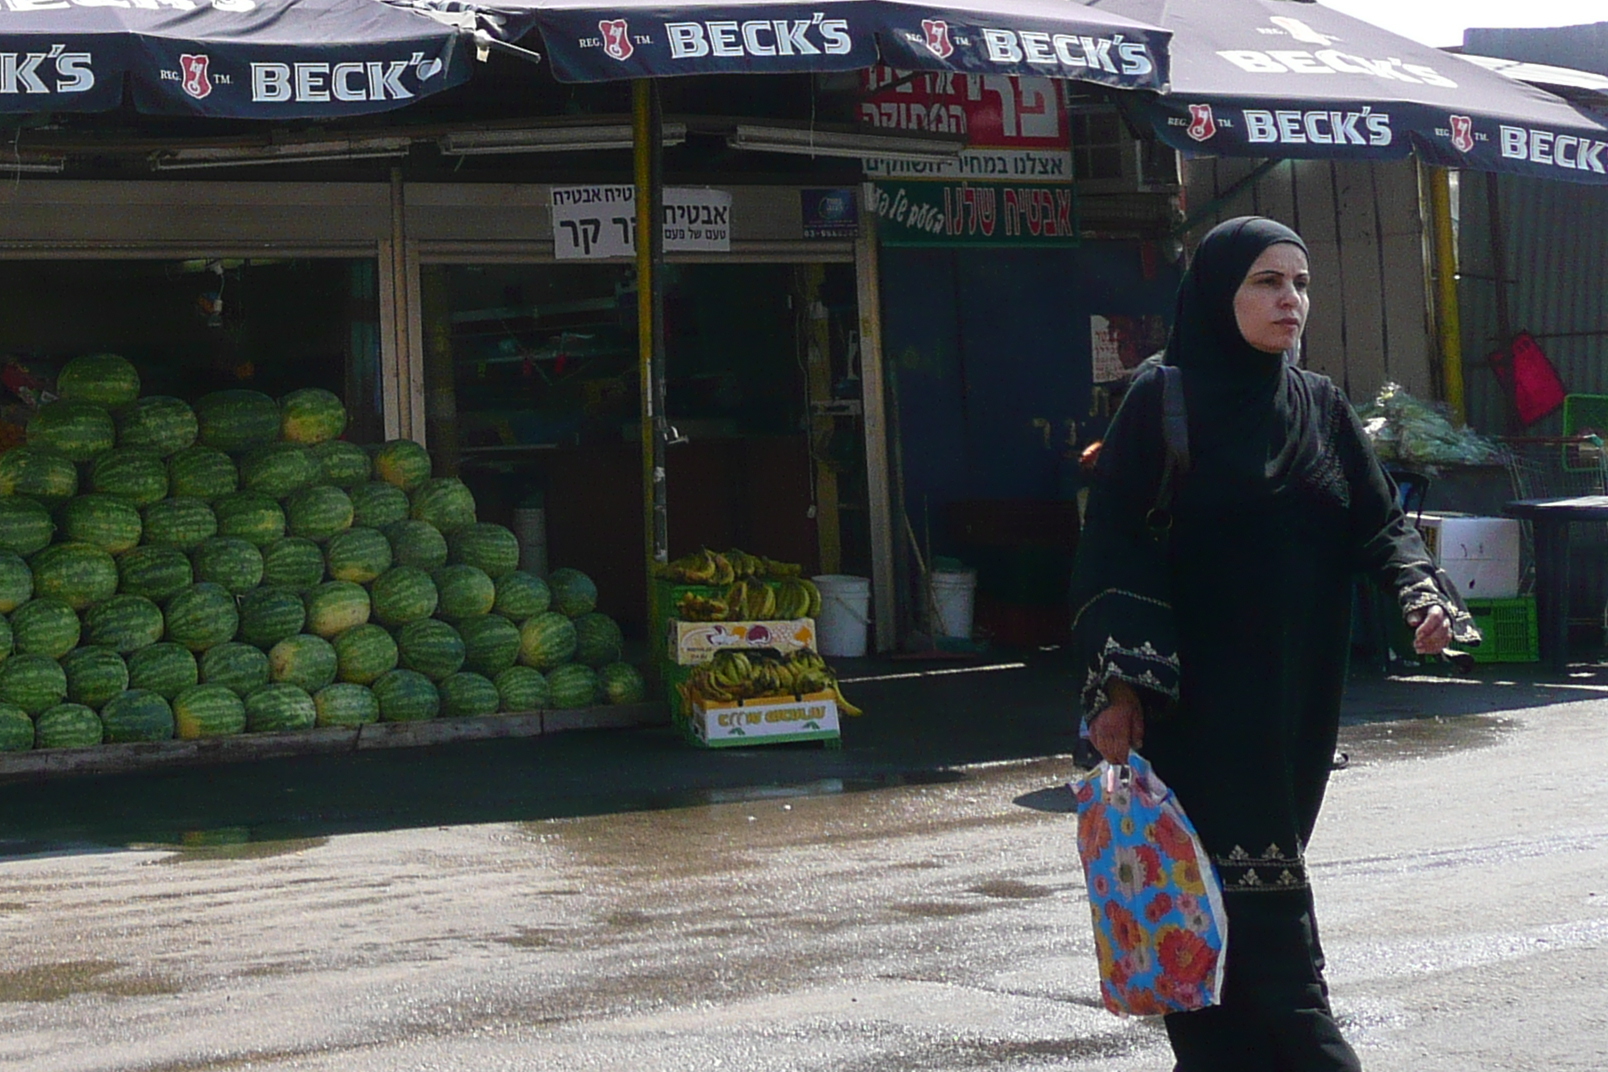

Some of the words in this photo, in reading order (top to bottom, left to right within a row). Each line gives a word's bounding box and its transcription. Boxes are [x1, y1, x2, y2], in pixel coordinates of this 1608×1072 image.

[664, 12, 852, 59] BECK'S
[981, 27, 1153, 76] BECK'S
[860, 102, 968, 135] המתוקה
[1242, 105, 1393, 147] BECK'S
[1013, 152, 1064, 176] אצלנו
[553, 187, 602, 206] אבטיח
[605, 186, 632, 204] טיח
[943, 182, 997, 237] שלנו
[663, 204, 728, 226] אבטיח
[1004, 188, 1073, 237] אבטיח
[560, 217, 602, 256] קר
[612, 216, 636, 245] ר
[688, 227, 703, 239] של
[705, 229, 727, 241] טעם
